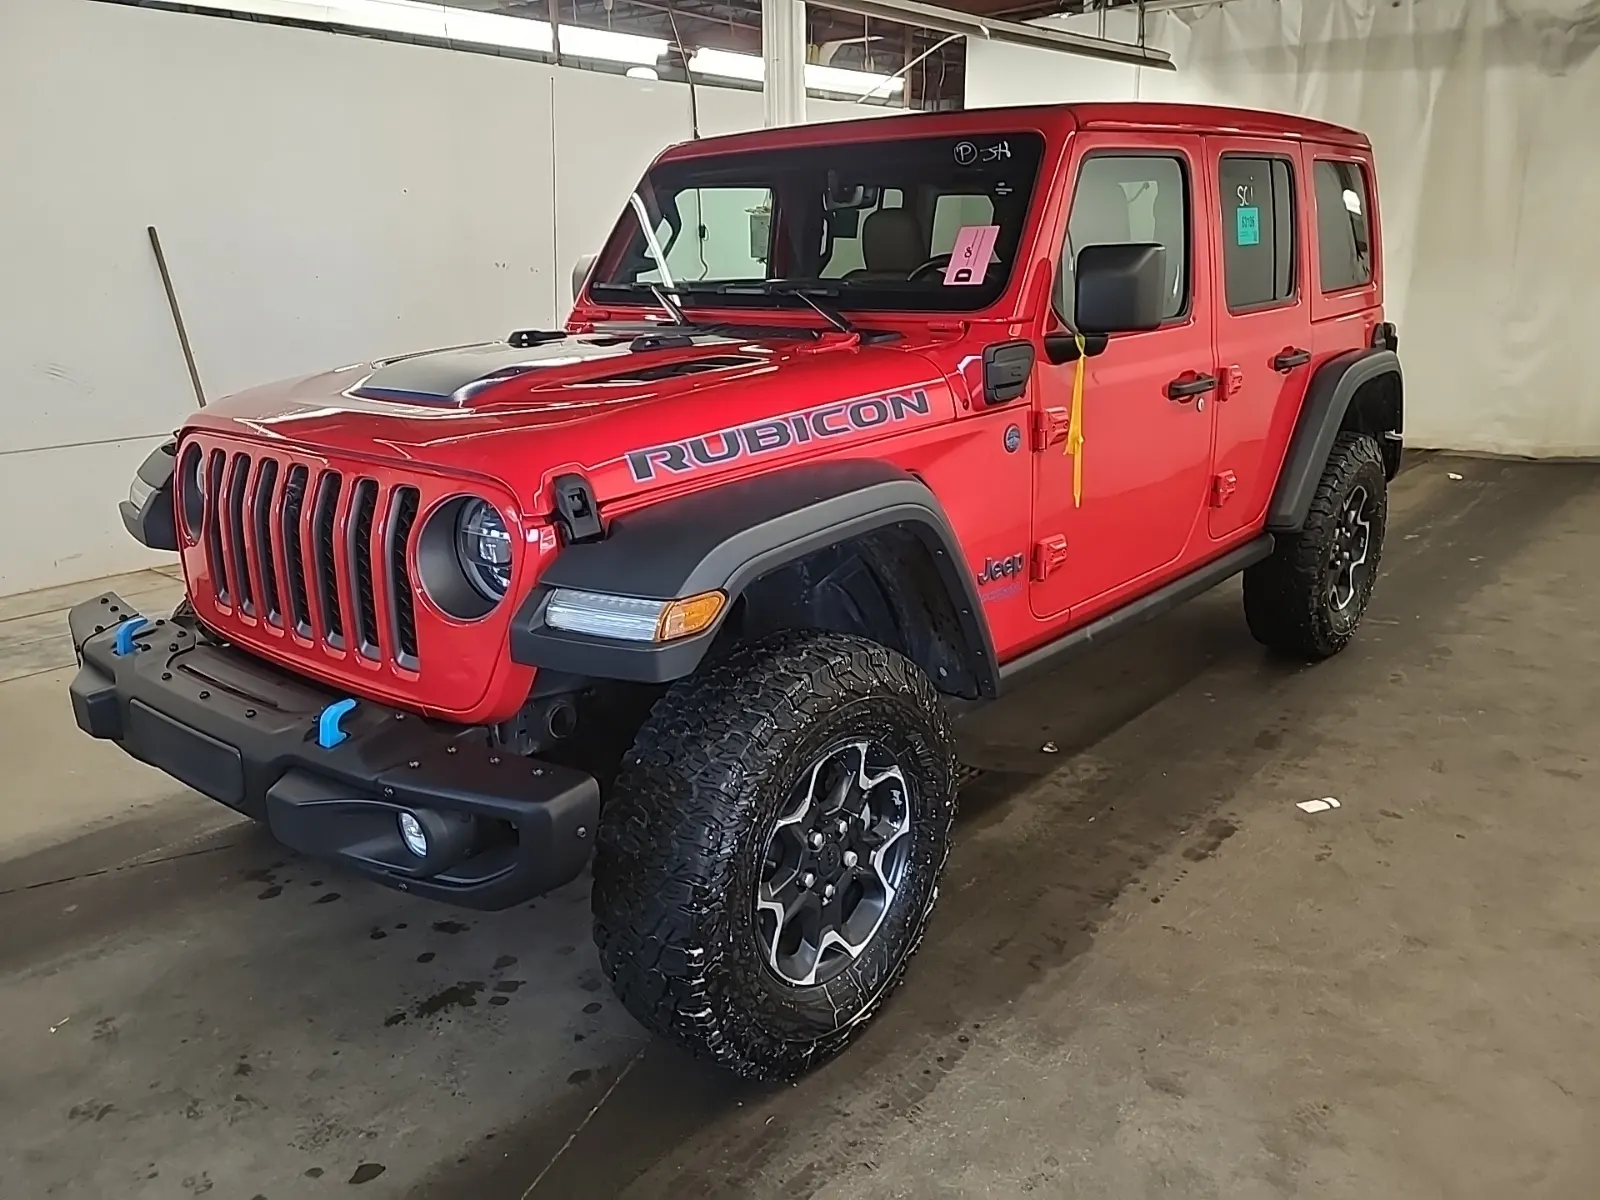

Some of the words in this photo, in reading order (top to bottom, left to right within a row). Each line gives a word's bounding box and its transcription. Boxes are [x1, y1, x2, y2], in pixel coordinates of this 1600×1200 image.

[954, 268, 973, 282] D
[625, 388, 930, 482] RUBICON
[977, 552, 1024, 586] Jeep
